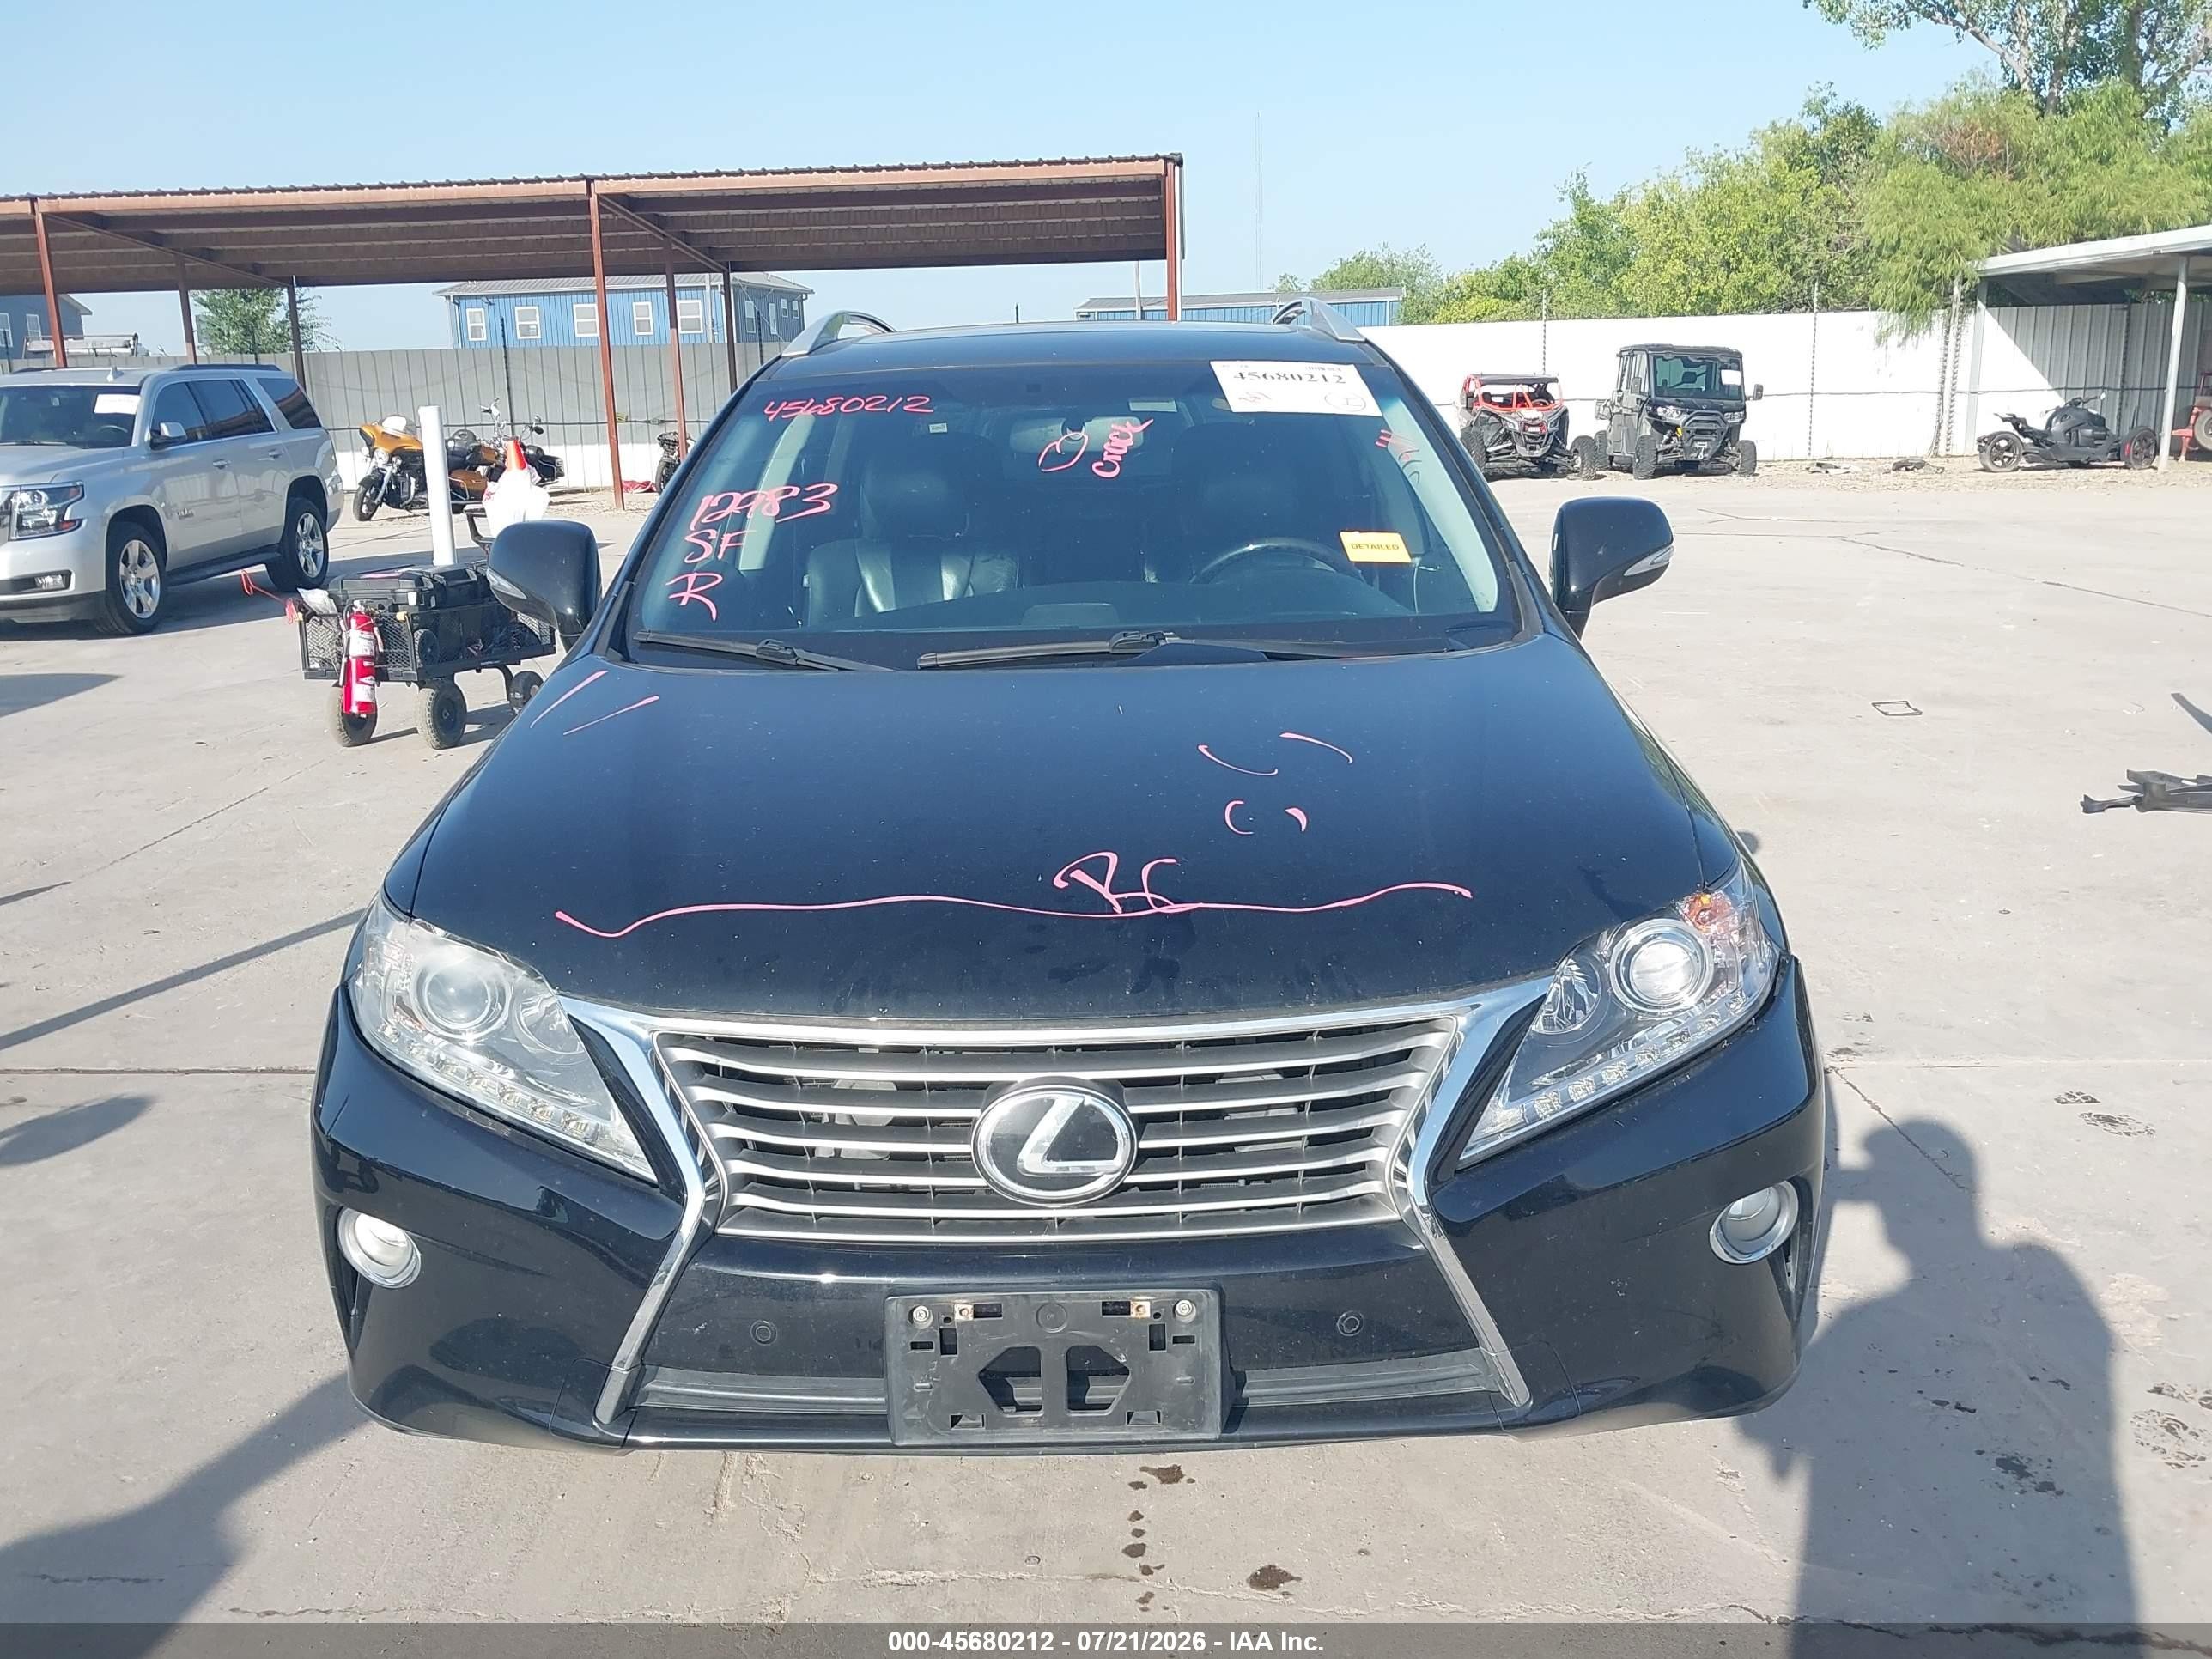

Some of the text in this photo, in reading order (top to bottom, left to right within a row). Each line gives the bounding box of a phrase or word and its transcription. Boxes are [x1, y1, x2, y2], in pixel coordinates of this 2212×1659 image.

[1233, 370, 1347, 385] 45680212
[763, 395, 935, 422] 45680212
[690, 483, 839, 532] 12983
[684, 528, 757, 564] SF
[665, 572, 723, 622] R
